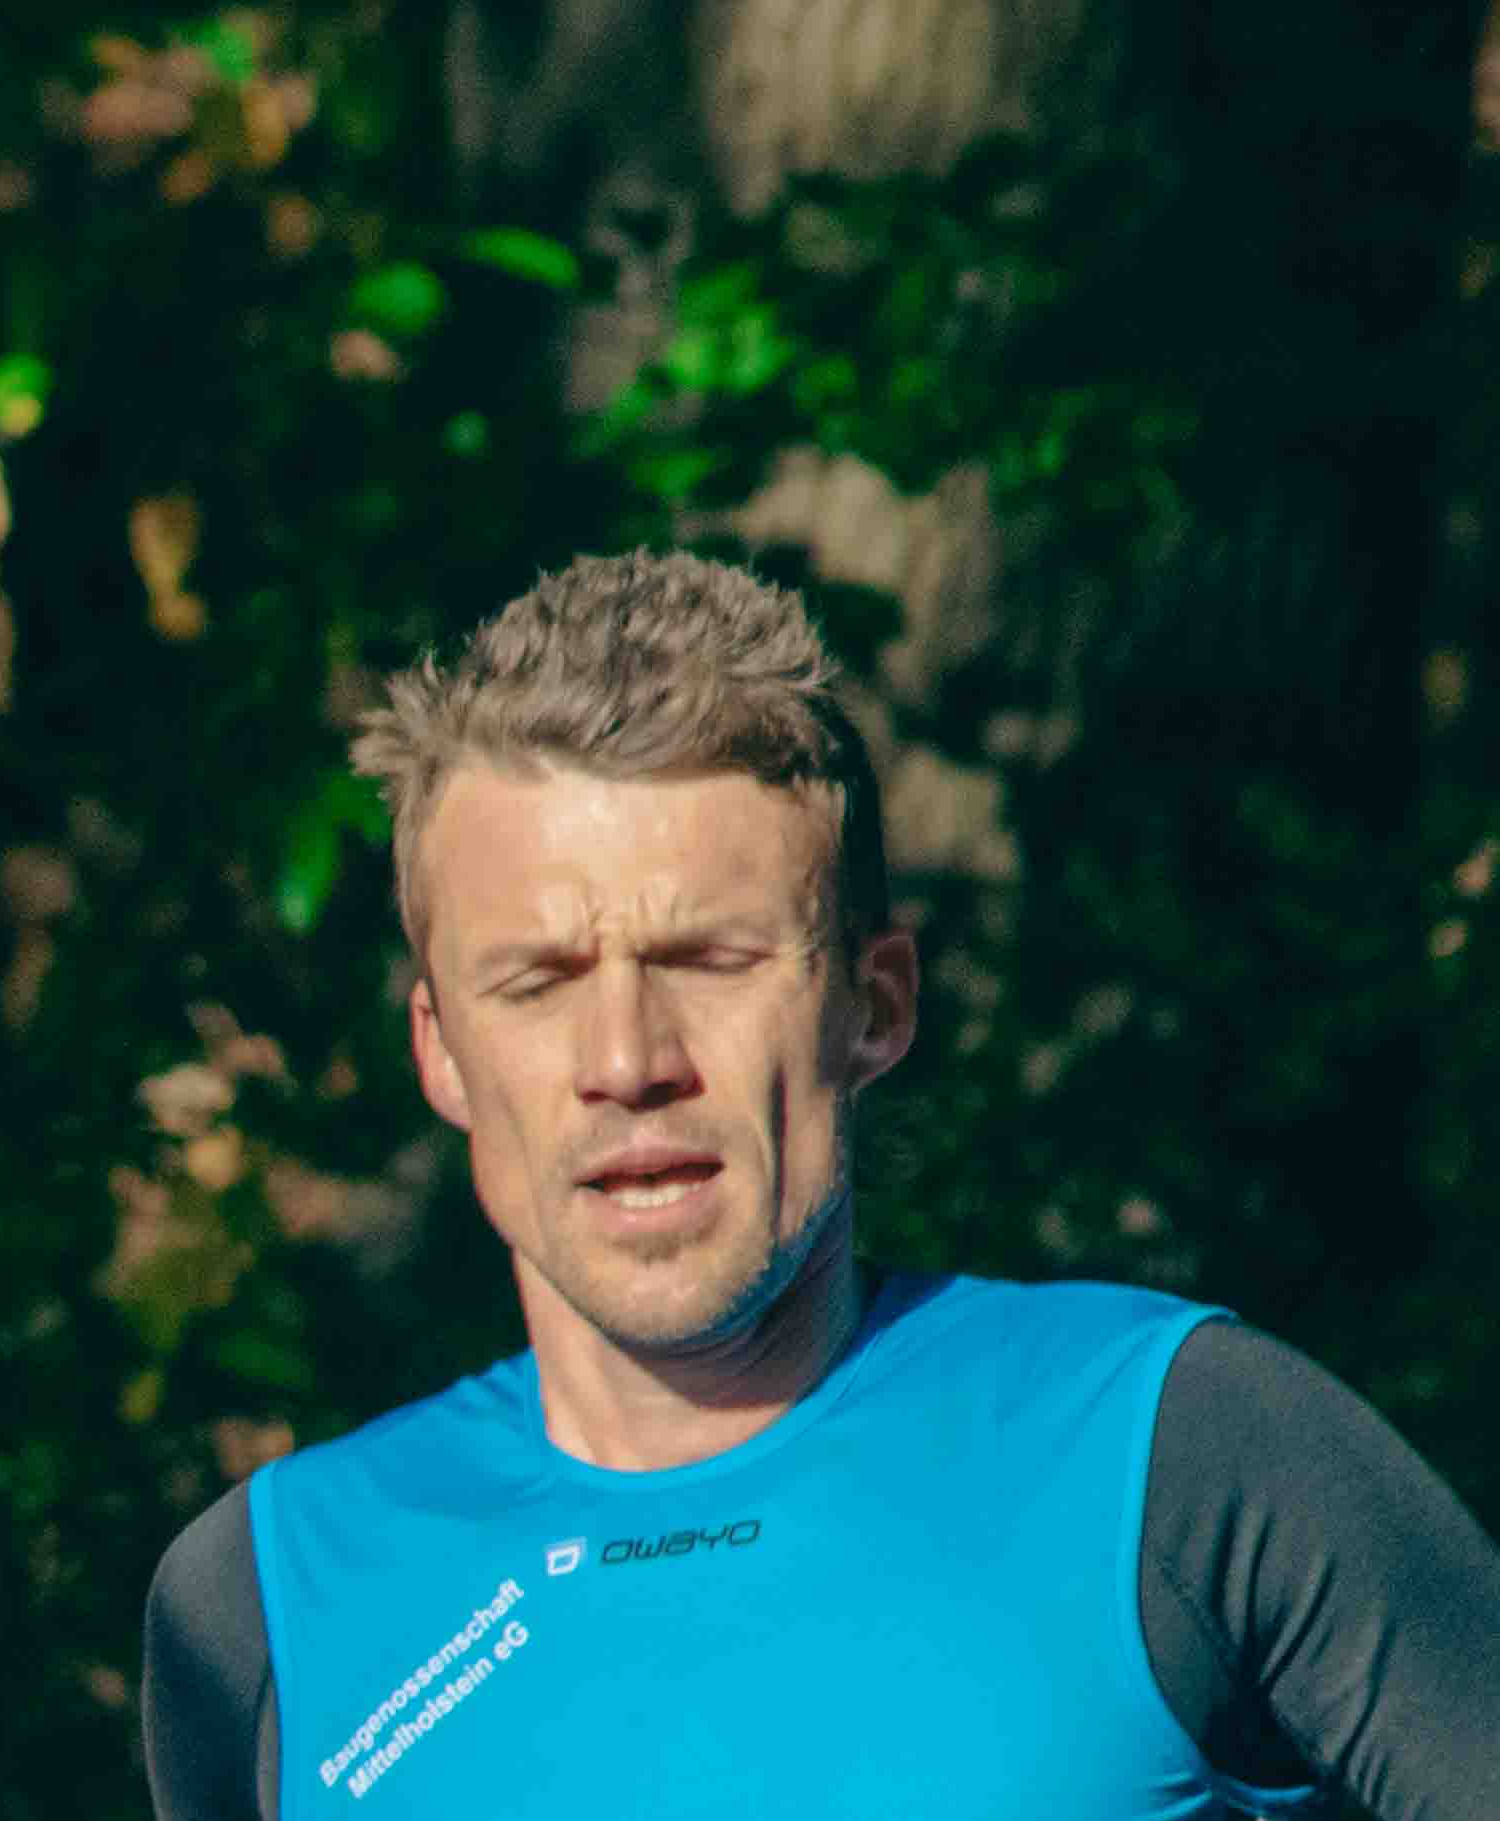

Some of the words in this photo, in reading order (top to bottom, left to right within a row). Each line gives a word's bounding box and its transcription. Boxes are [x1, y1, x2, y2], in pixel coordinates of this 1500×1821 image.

[319, 1578, 524, 1787] Baugenossenschaft
[348, 1656, 494, 1799] Mittelholstein
[493, 1620, 528, 1660] eG
